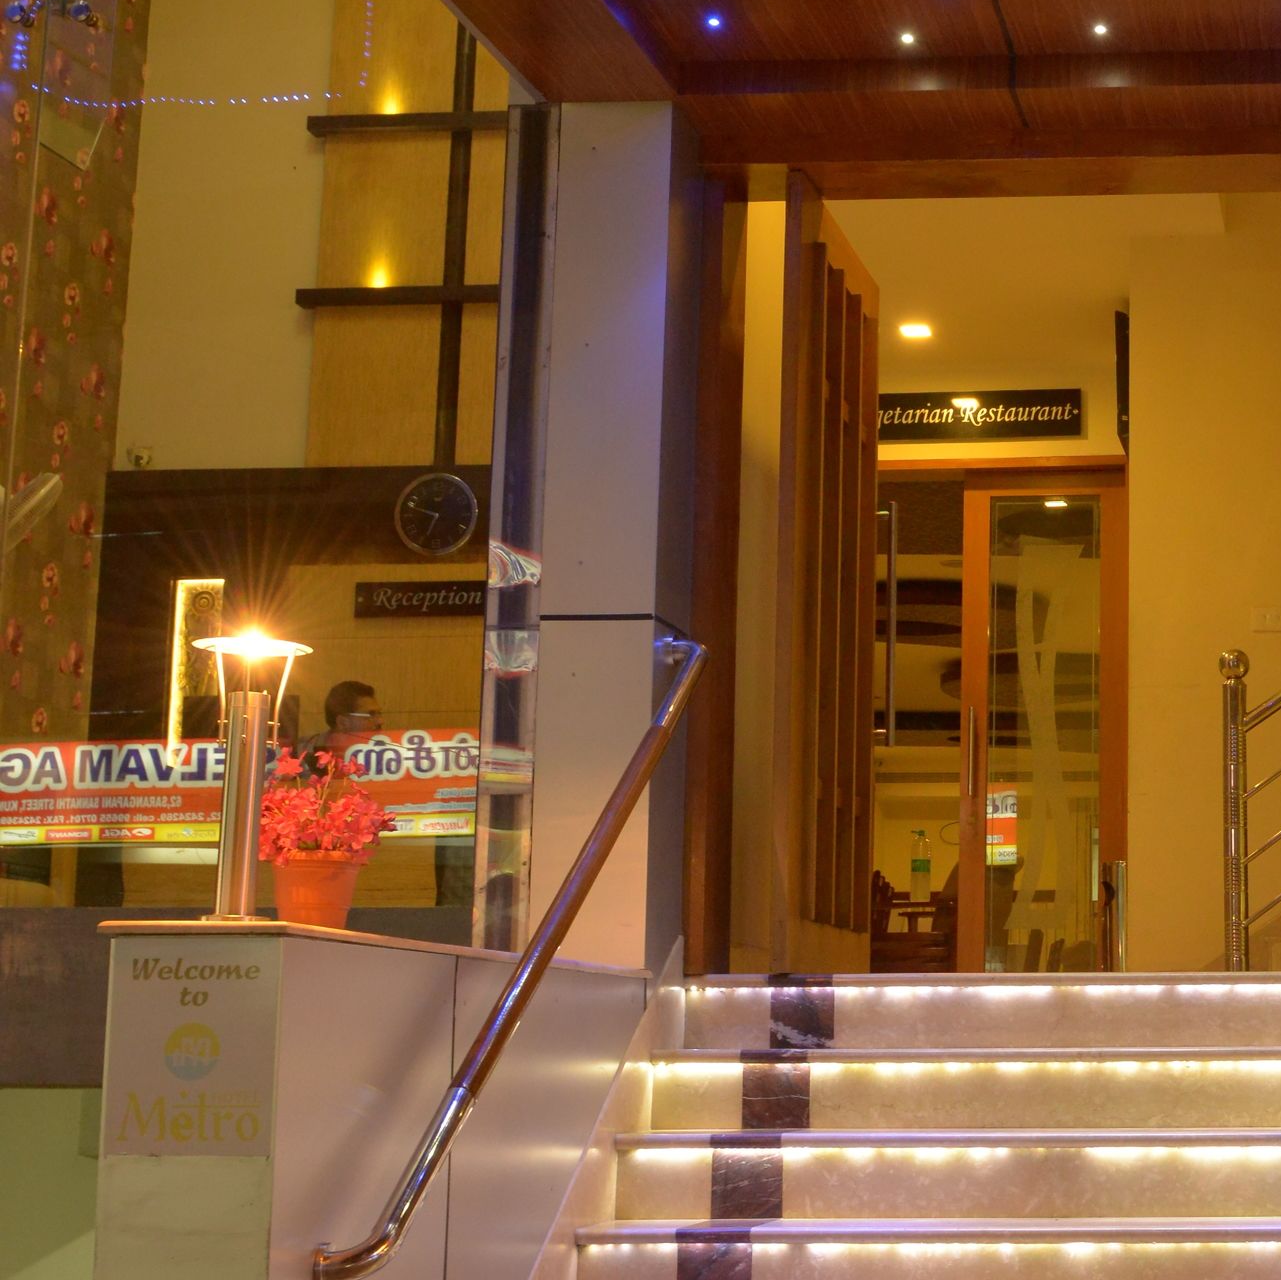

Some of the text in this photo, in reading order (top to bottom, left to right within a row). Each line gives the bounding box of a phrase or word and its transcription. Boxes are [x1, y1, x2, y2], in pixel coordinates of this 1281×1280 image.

[960, 403, 1072, 426] Restaurant
[372, 586, 482, 612] Reception
[132, 957, 261, 981] Welcome
[179, 986, 209, 1007] to
[115, 1089, 262, 1143] Metro
